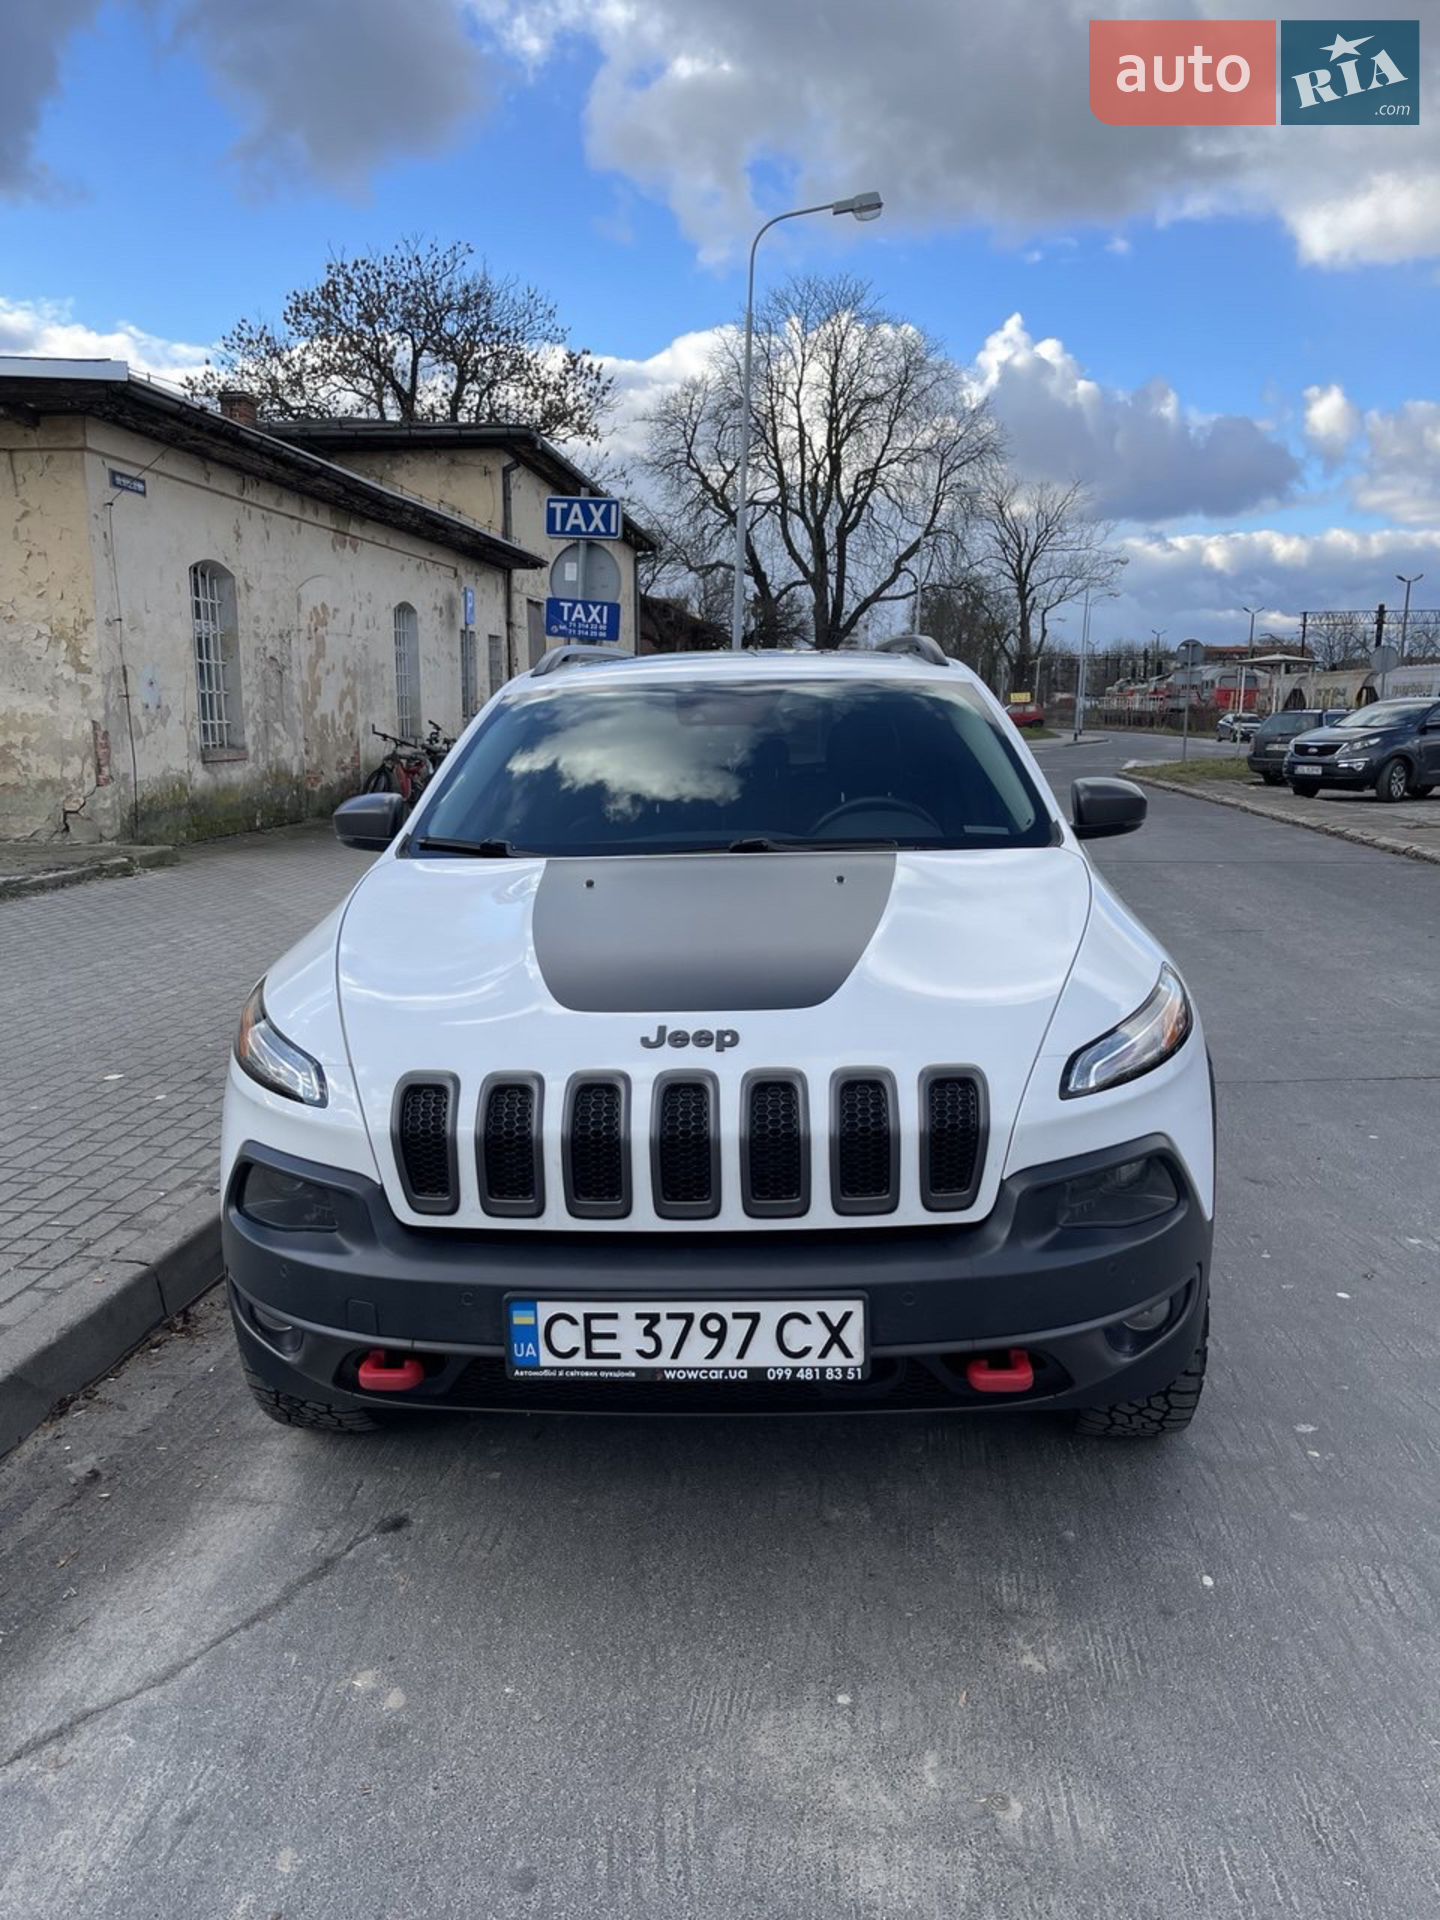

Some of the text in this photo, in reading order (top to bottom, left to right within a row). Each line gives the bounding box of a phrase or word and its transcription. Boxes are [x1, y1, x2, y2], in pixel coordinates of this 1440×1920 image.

[550, 502, 618, 533] TAXI
[559, 602, 608, 624] TAXI
[640, 1025, 740, 1052] Jeep
[543, 1311, 855, 1360] CE 3797 CX
[514, 1343, 537, 1357] UA
[664, 1368, 748, 1380] wowcar.ua
[767, 1368, 862, 1380] 099 481 83 51
